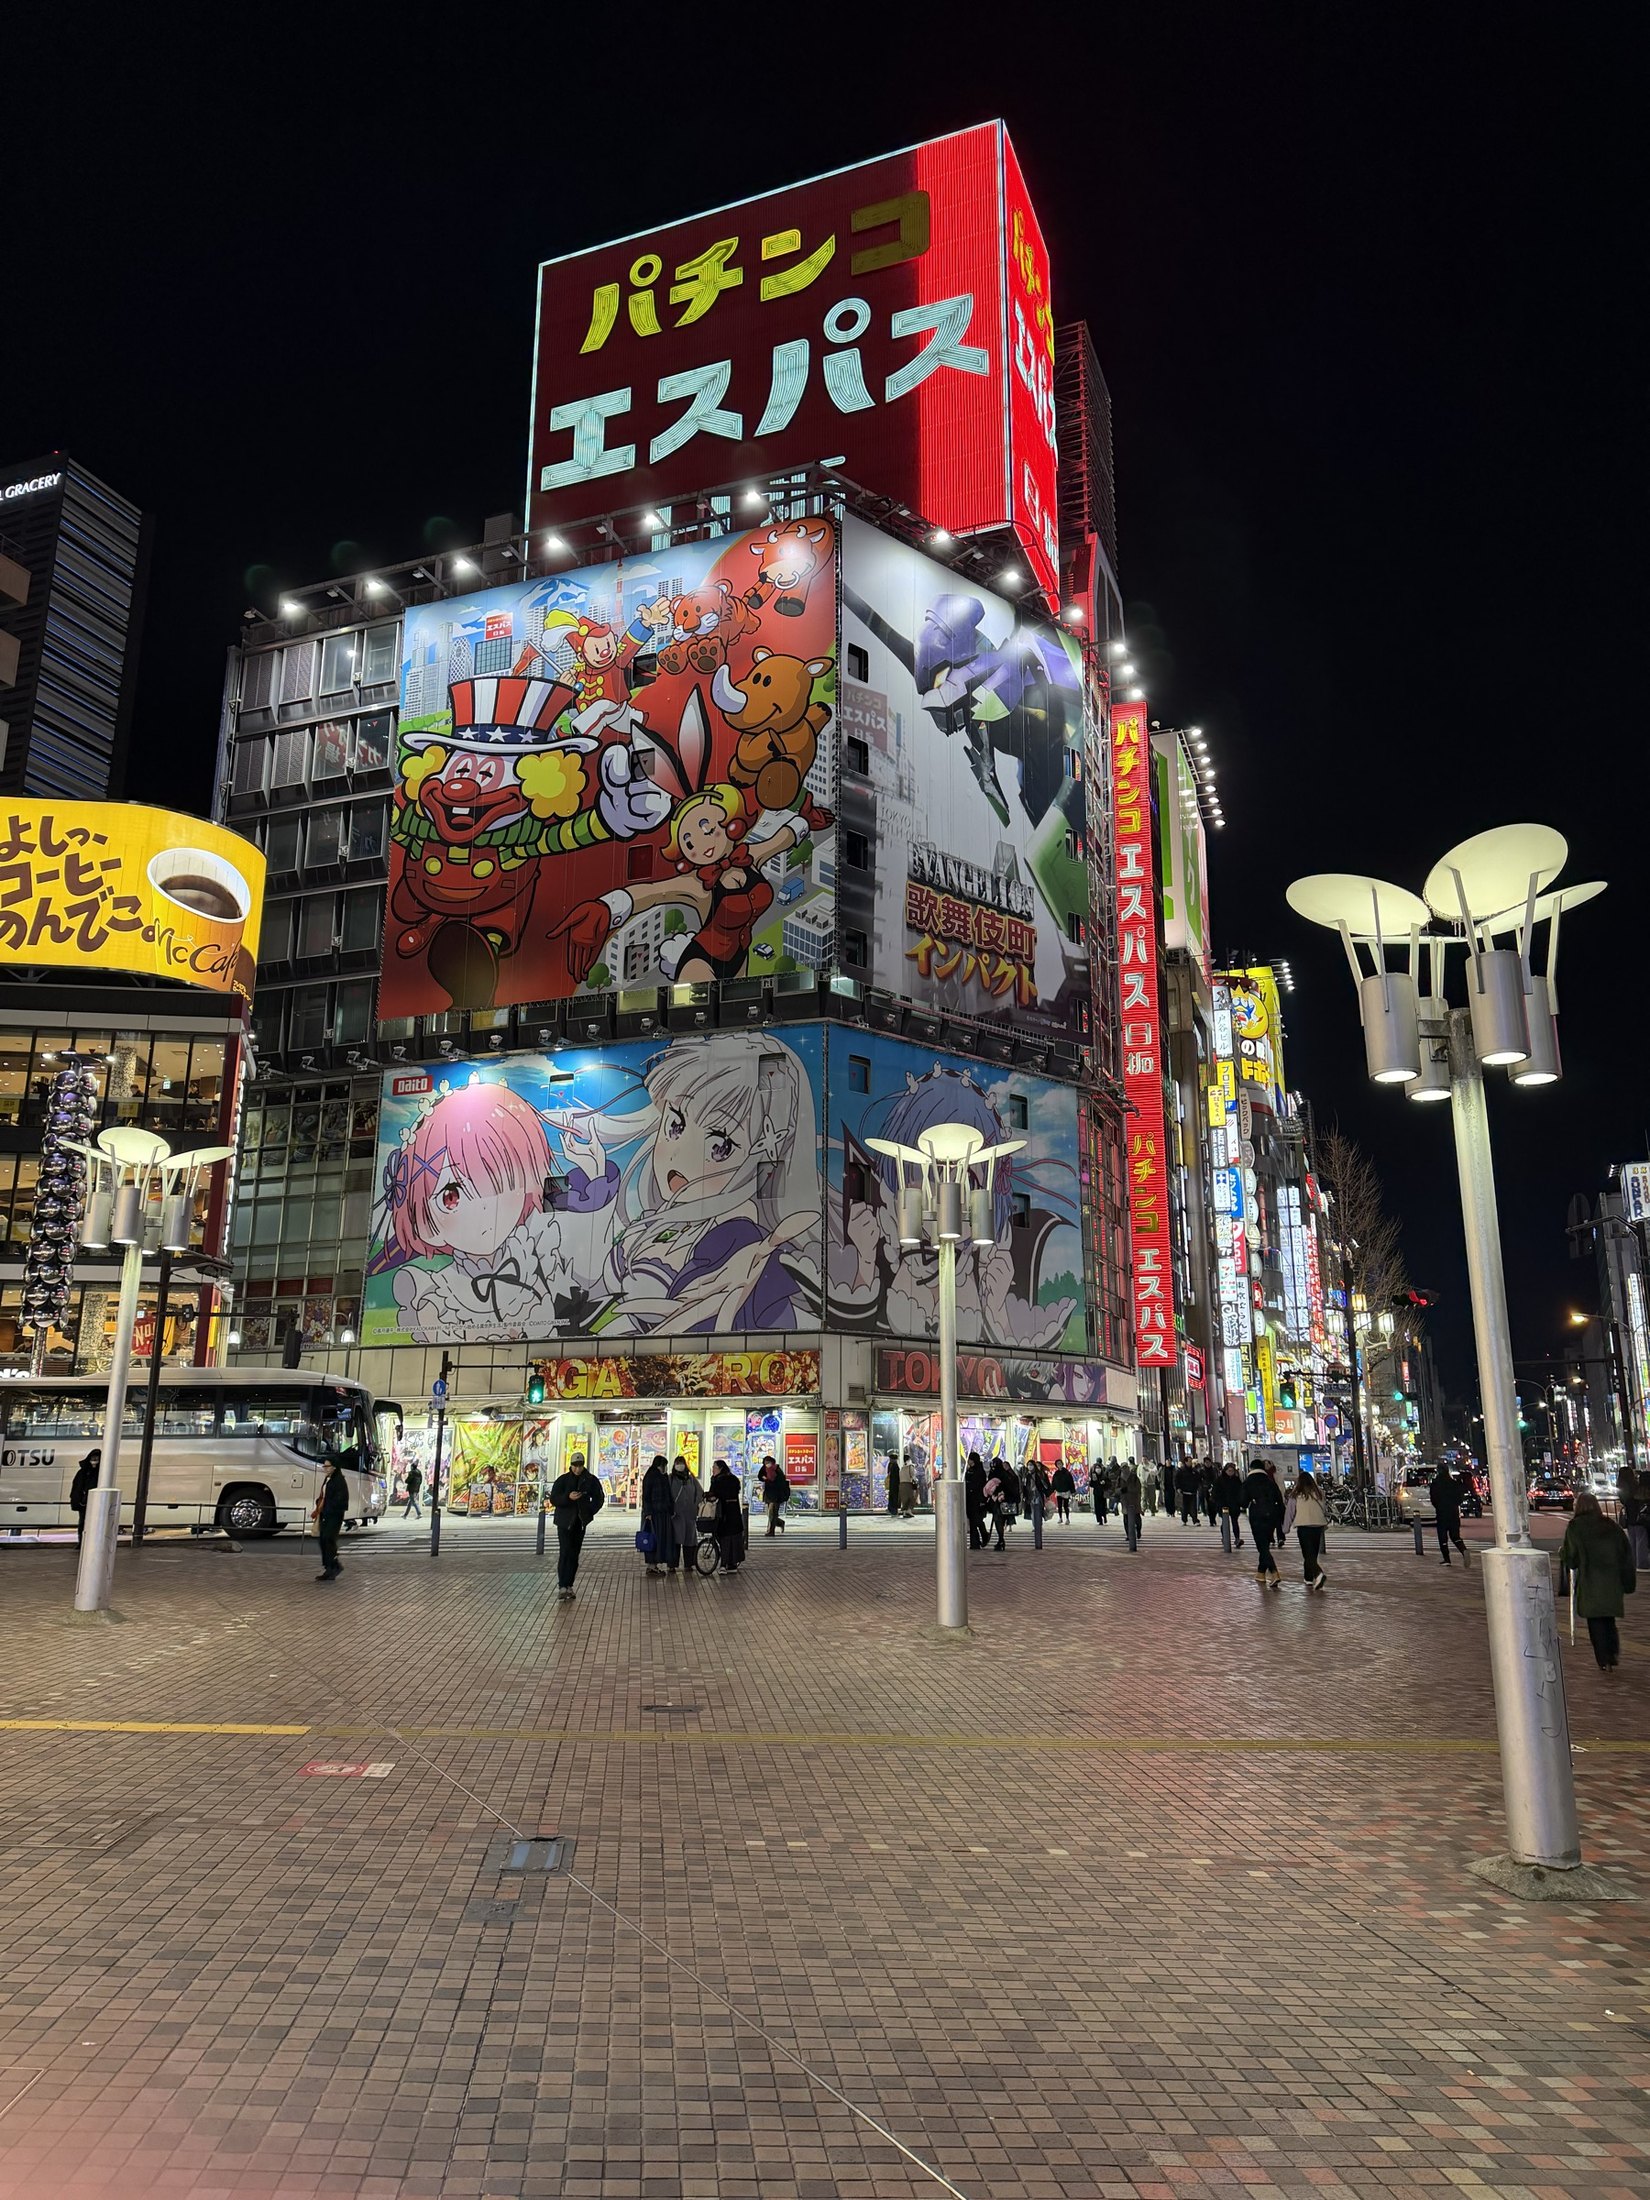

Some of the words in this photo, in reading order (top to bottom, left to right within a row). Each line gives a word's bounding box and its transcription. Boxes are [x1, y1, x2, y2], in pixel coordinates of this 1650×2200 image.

[579, 190, 930, 354] パチンコ
[540, 293, 990, 491] エスパス
[5, 472, 61, 498] GRACERY
[843, 706, 886, 732] エスパス
[1116, 717, 1141, 833] パチンコ
[905, 932, 1038, 1006] インパクト
[906, 880, 1038, 965] 歌舞伎町
[1132, 1132, 1159, 1234] パチンコ
[1137, 1248, 1168, 1359] エスパス
[788, 1455, 814, 1464] エスパス
